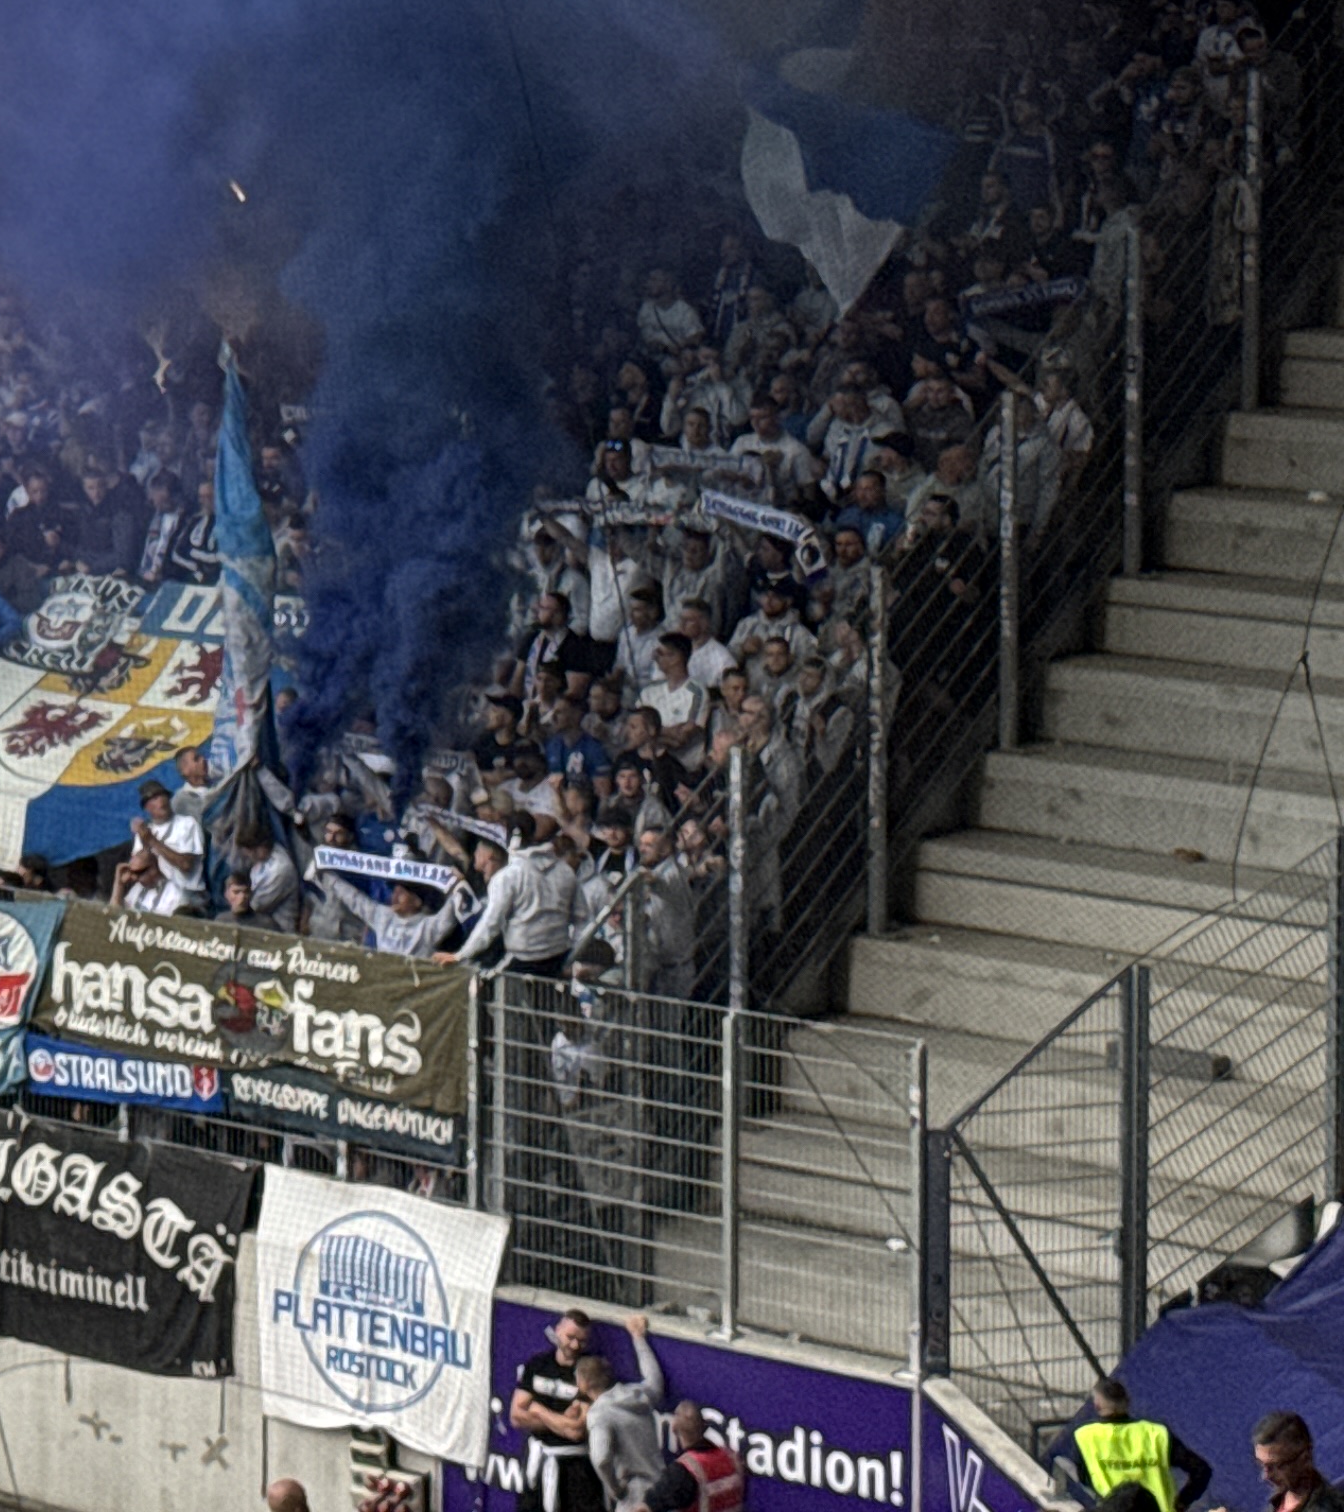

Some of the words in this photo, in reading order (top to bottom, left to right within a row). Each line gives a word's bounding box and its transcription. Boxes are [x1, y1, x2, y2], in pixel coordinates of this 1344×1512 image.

[50, 941, 216, 1034] hansa
[290, 980, 422, 1075] fans
[54, 1052, 193, 1100] STRALSUND
[272, 1287, 472, 1371] PLATTENBAU
[325, 1345, 419, 1391] ROSTOCK
